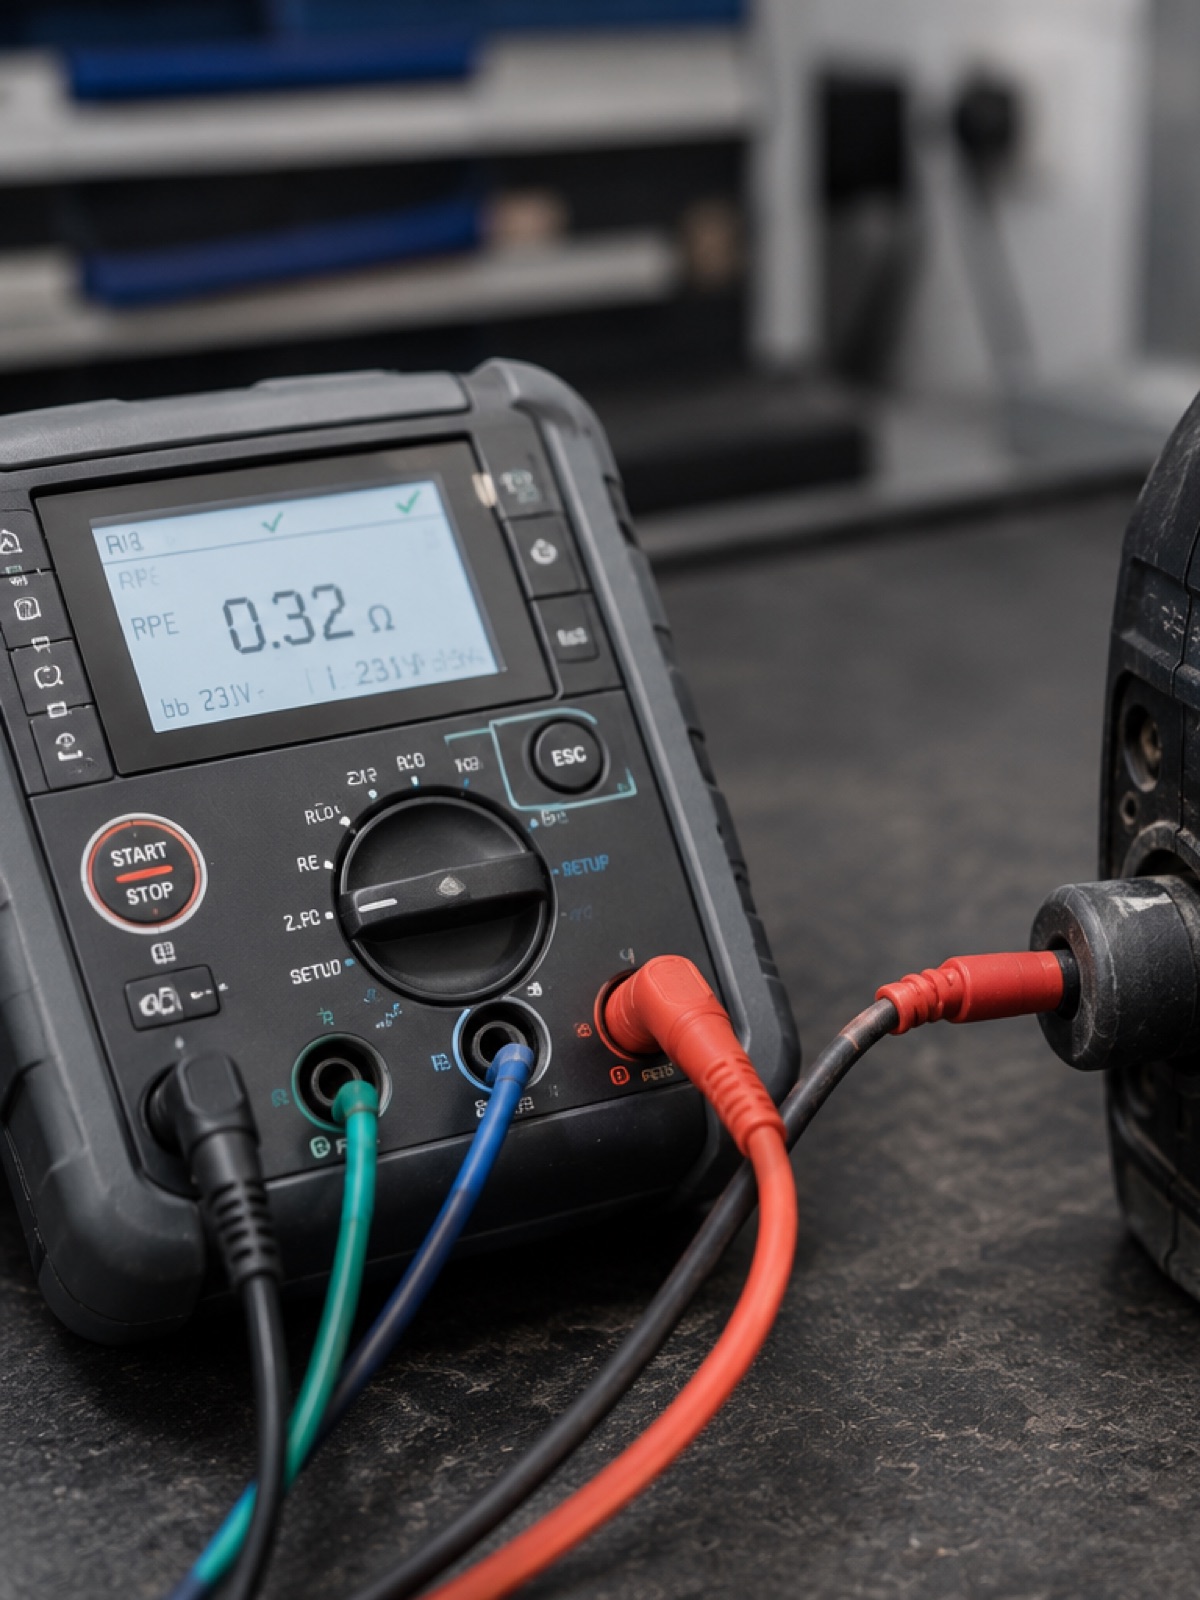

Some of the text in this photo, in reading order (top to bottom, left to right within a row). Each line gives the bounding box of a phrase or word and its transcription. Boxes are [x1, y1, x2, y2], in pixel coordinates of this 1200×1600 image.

[130, 583, 396, 655] RPE 0.32 Ω
[551, 745, 587, 767] ESC
[110, 841, 167, 868] START
[296, 854, 320, 873] RE
[126, 881, 175, 905] STOP
